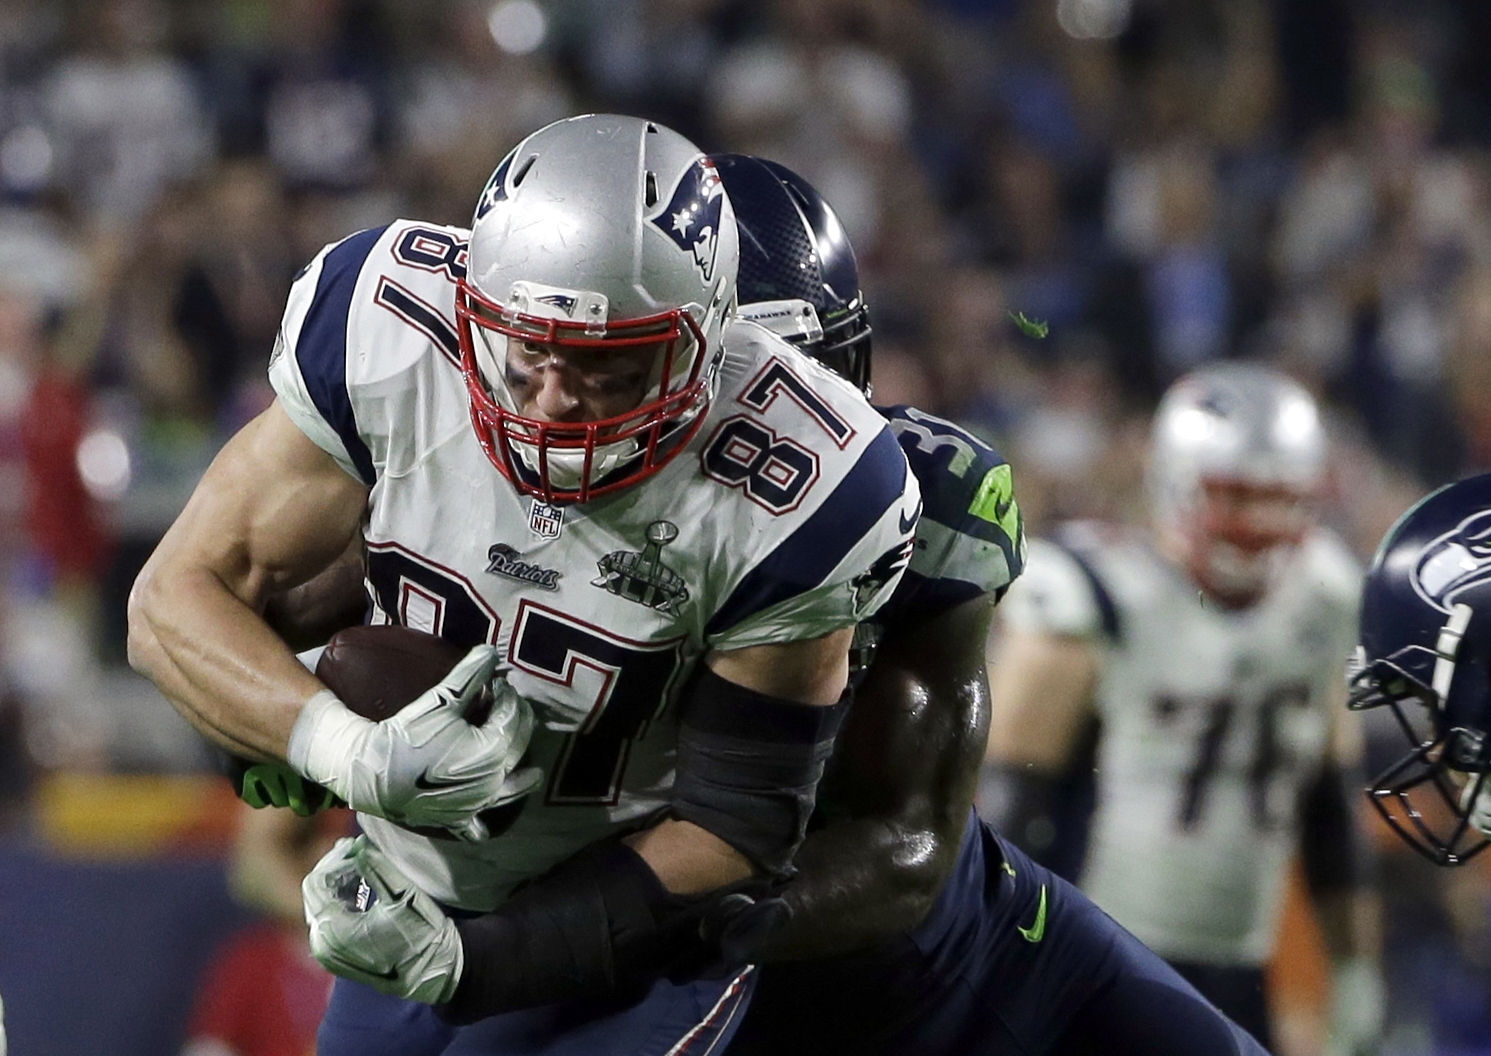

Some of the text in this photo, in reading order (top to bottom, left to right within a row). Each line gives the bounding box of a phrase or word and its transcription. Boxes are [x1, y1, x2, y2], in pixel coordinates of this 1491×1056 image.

[702, 355, 857, 517] 87
[533, 515, 557, 536] NFL
[484, 553, 561, 592] Patriots
[589, 570, 686, 619] XLIX
